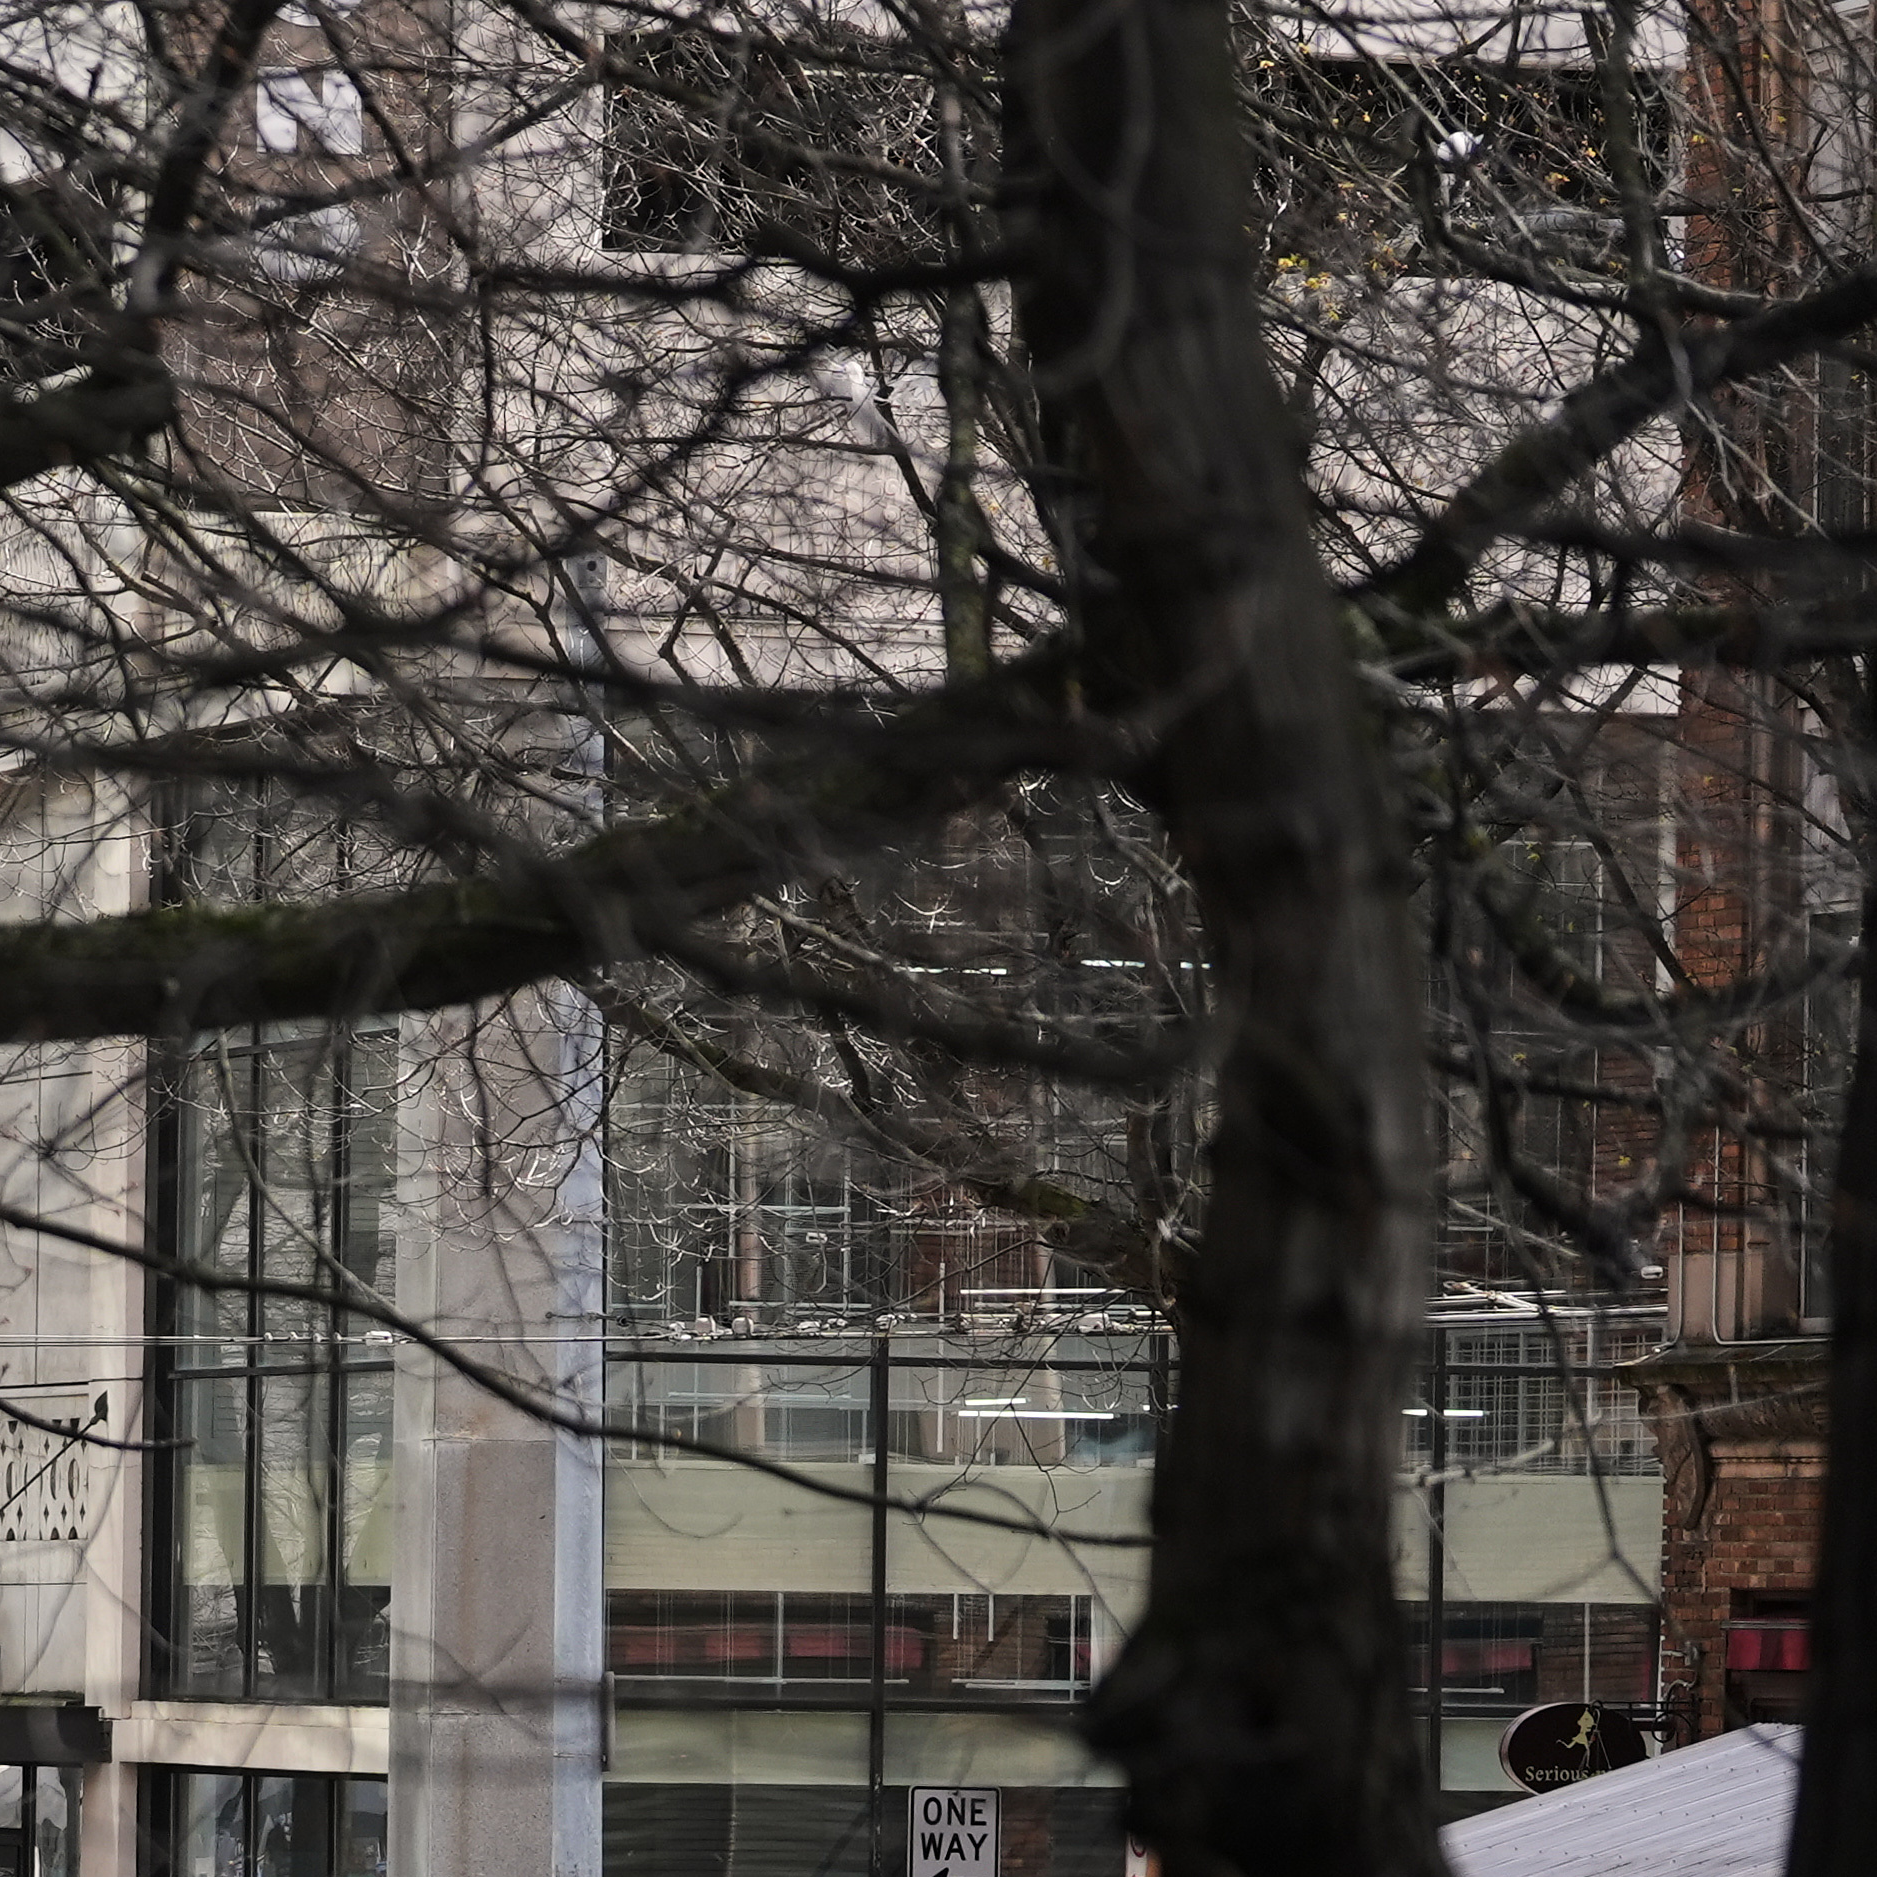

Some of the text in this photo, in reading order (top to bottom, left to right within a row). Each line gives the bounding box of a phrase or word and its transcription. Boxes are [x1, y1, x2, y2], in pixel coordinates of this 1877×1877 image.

[1525, 1766, 1588, 1781] Serious
[923, 1797, 987, 1825] ONE
[921, 1834, 988, 1860] WAY
